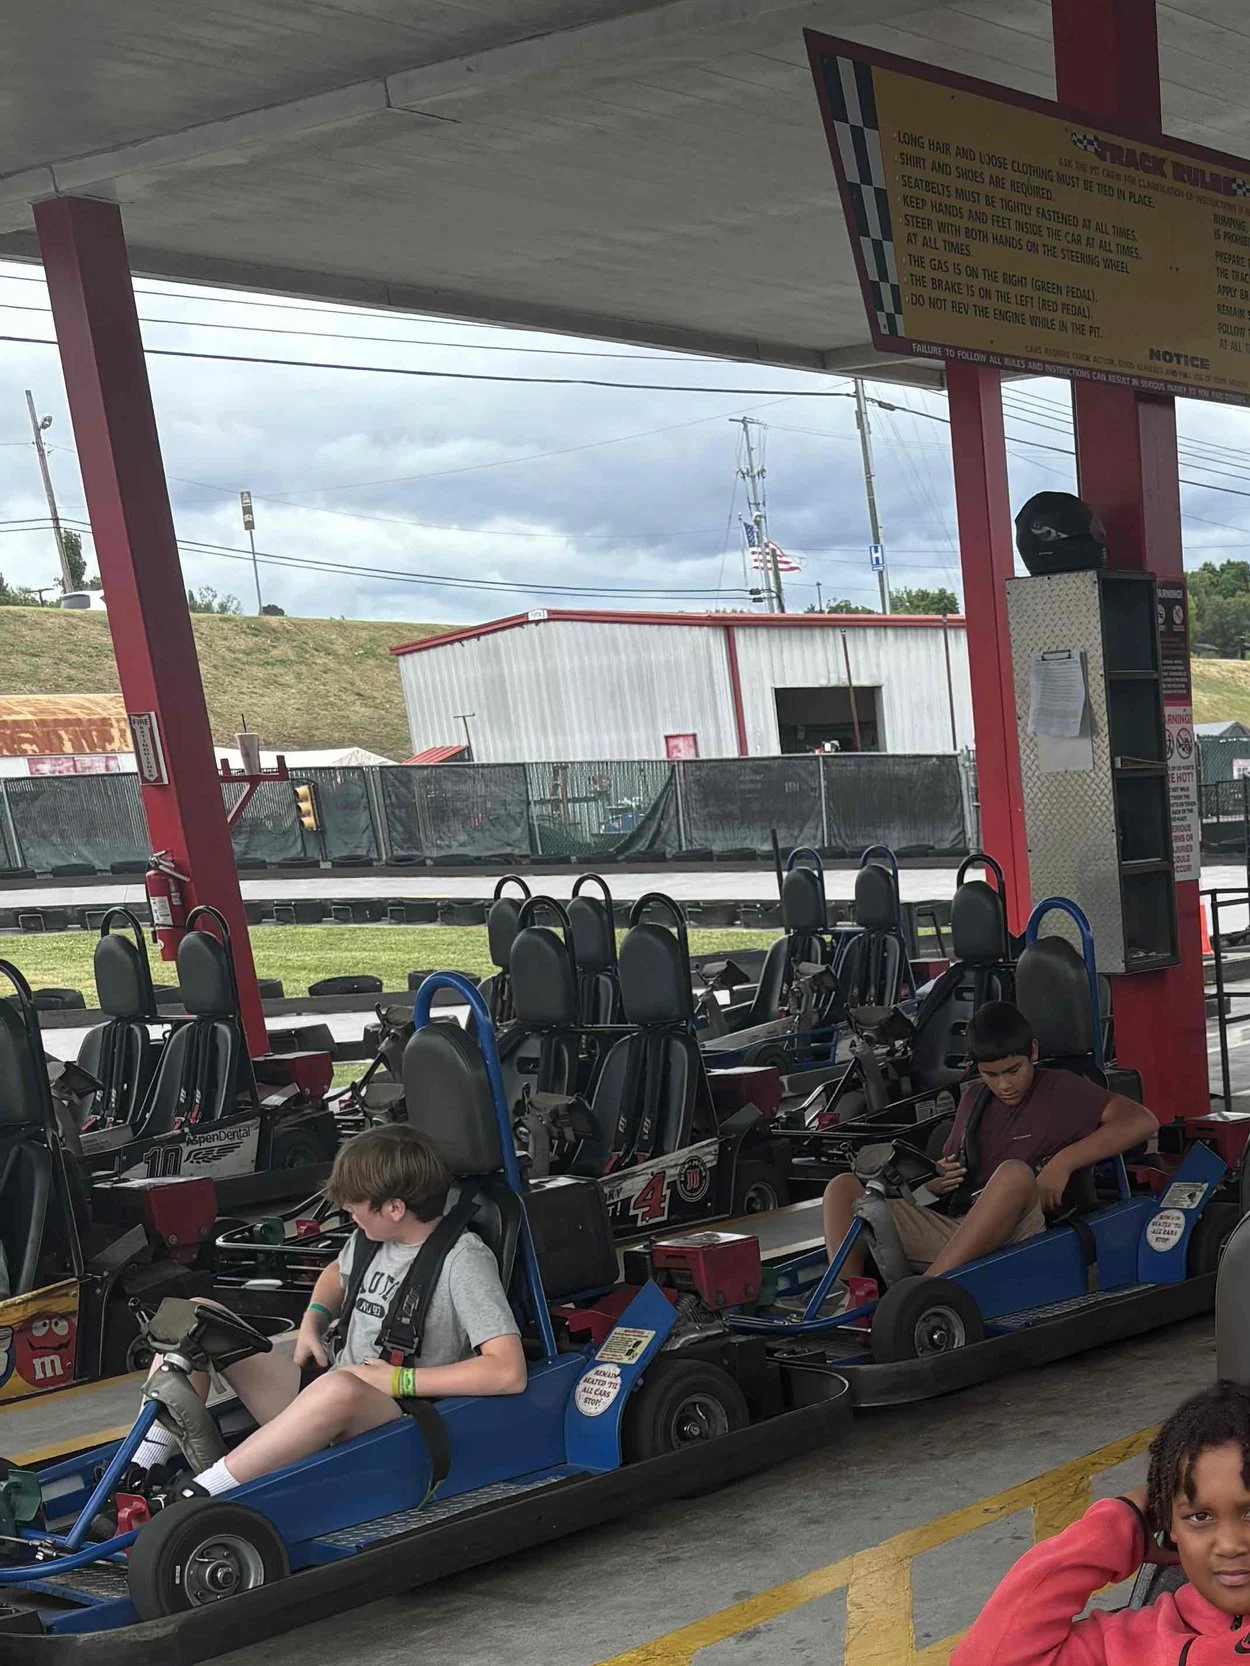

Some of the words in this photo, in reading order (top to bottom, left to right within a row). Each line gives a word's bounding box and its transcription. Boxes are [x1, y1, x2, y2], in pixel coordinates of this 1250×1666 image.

[895, 129, 925, 150] LONG
[927, 138, 951, 156] HAIR
[954, 145, 976, 163] AND
[978, 151, 1008, 171] LOOSE
[1010, 159, 1053, 182] CLOTHING
[1056, 171, 1080, 189] MUST
[1083, 178, 1093, 192] BE
[1096, 182, 1114, 198] TIED
[1116, 187, 1125, 201] IN
[1128, 190, 1155, 208] PLACE.
[897, 151, 927, 170] SHIRT
[930, 159, 952, 177] AND
[954, 165, 985, 185] SHOES
[987, 173, 1006, 190] ARE
[1009, 179, 1054, 203] REQUIRED.
[1096, 138, 1166, 178] TRACK
[1170, 159, 1237, 198] RULES
[900, 174, 951, 198] SEATBELTS
[954, 186, 981, 205] MUST
[984, 194, 997, 209] BE
[999, 197, 1033, 217] TIGHTLY
[1035, 206, 1078, 228] FASTENED
[1081, 217, 1092, 231] AT
[1095, 220, 1108, 235] ALL
[1112, 224, 1137, 241] TIMES.
[901, 193, 927, 211] KEEP
[930, 200, 964, 219] HANDS
[966, 208, 988, 225] AND
[990, 214, 1012, 230] FEET
[1014, 219, 1042, 237] INSIDE
[1046, 226, 1062, 241] THE
[1064, 231, 1081, 246] CAR
[1085, 235, 1095, 249] AT
[1098, 238, 1112, 253] ALL
[1115, 242, 1141, 259] TIMES.
[903, 213, 934, 231] STEER
[936, 220, 961, 237] WITH
[963, 226, 989, 243] BOTH
[991, 232, 1023, 251] HANDS
[1025, 240, 1039, 254] ON
[1042, 243, 1057, 258] THE
[1060, 247, 1099, 267] STEERING
[1102, 257, 1129, 274] WHEEL
[904, 231, 918, 246] AT
[920, 235, 939, 250] ALL
[941, 239, 973, 257] TIMES.
[906, 252, 926, 269] THE
[928, 257, 950, 273] GAS
[952, 262, 962, 276] IS
[964, 264, 979, 279] ON
[981, 268, 998, 283] THE
[1001, 272, 1028, 289] RIGHT
[1031, 278, 1062, 296] (GREEN
[1065, 285, 1098, 302] PEDAL).
[1216, 266, 1228, 279] THE
[908, 273, 927, 288] THE
[929, 277, 963, 295] BRAKE
[965, 284, 974, 297] IS
[977, 286, 992, 300] ON
[994, 289, 1011, 304] THE
[1014, 293, 1034, 308] LEFT
[1037, 298, 1057, 313] (RED
[1060, 302, 1092, 319] PEDAL).
[909, 293, 925, 307] DO
[927, 296, 948, 311] NOT
[950, 300, 969, 315] REV
[972, 304, 990, 318] THE
[992, 308, 1026, 325] ENGINE
[1029, 315, 1055, 330] WHILE
[1058, 320, 1067, 332] IN
[1070, 322, 1085, 335] THE
[1088, 326, 1102, 338] PIT.
[1149, 348, 1209, 370] NOTICE
[1230, 340, 1241, 352] ALL
[1157, 588, 1183, 599] ARNING!
[132, 718, 149, 726] FIRE
[143, 1144, 183, 1178] 10
[630, 1170, 671, 1227] 4
[32, 1354, 64, 1380] m
